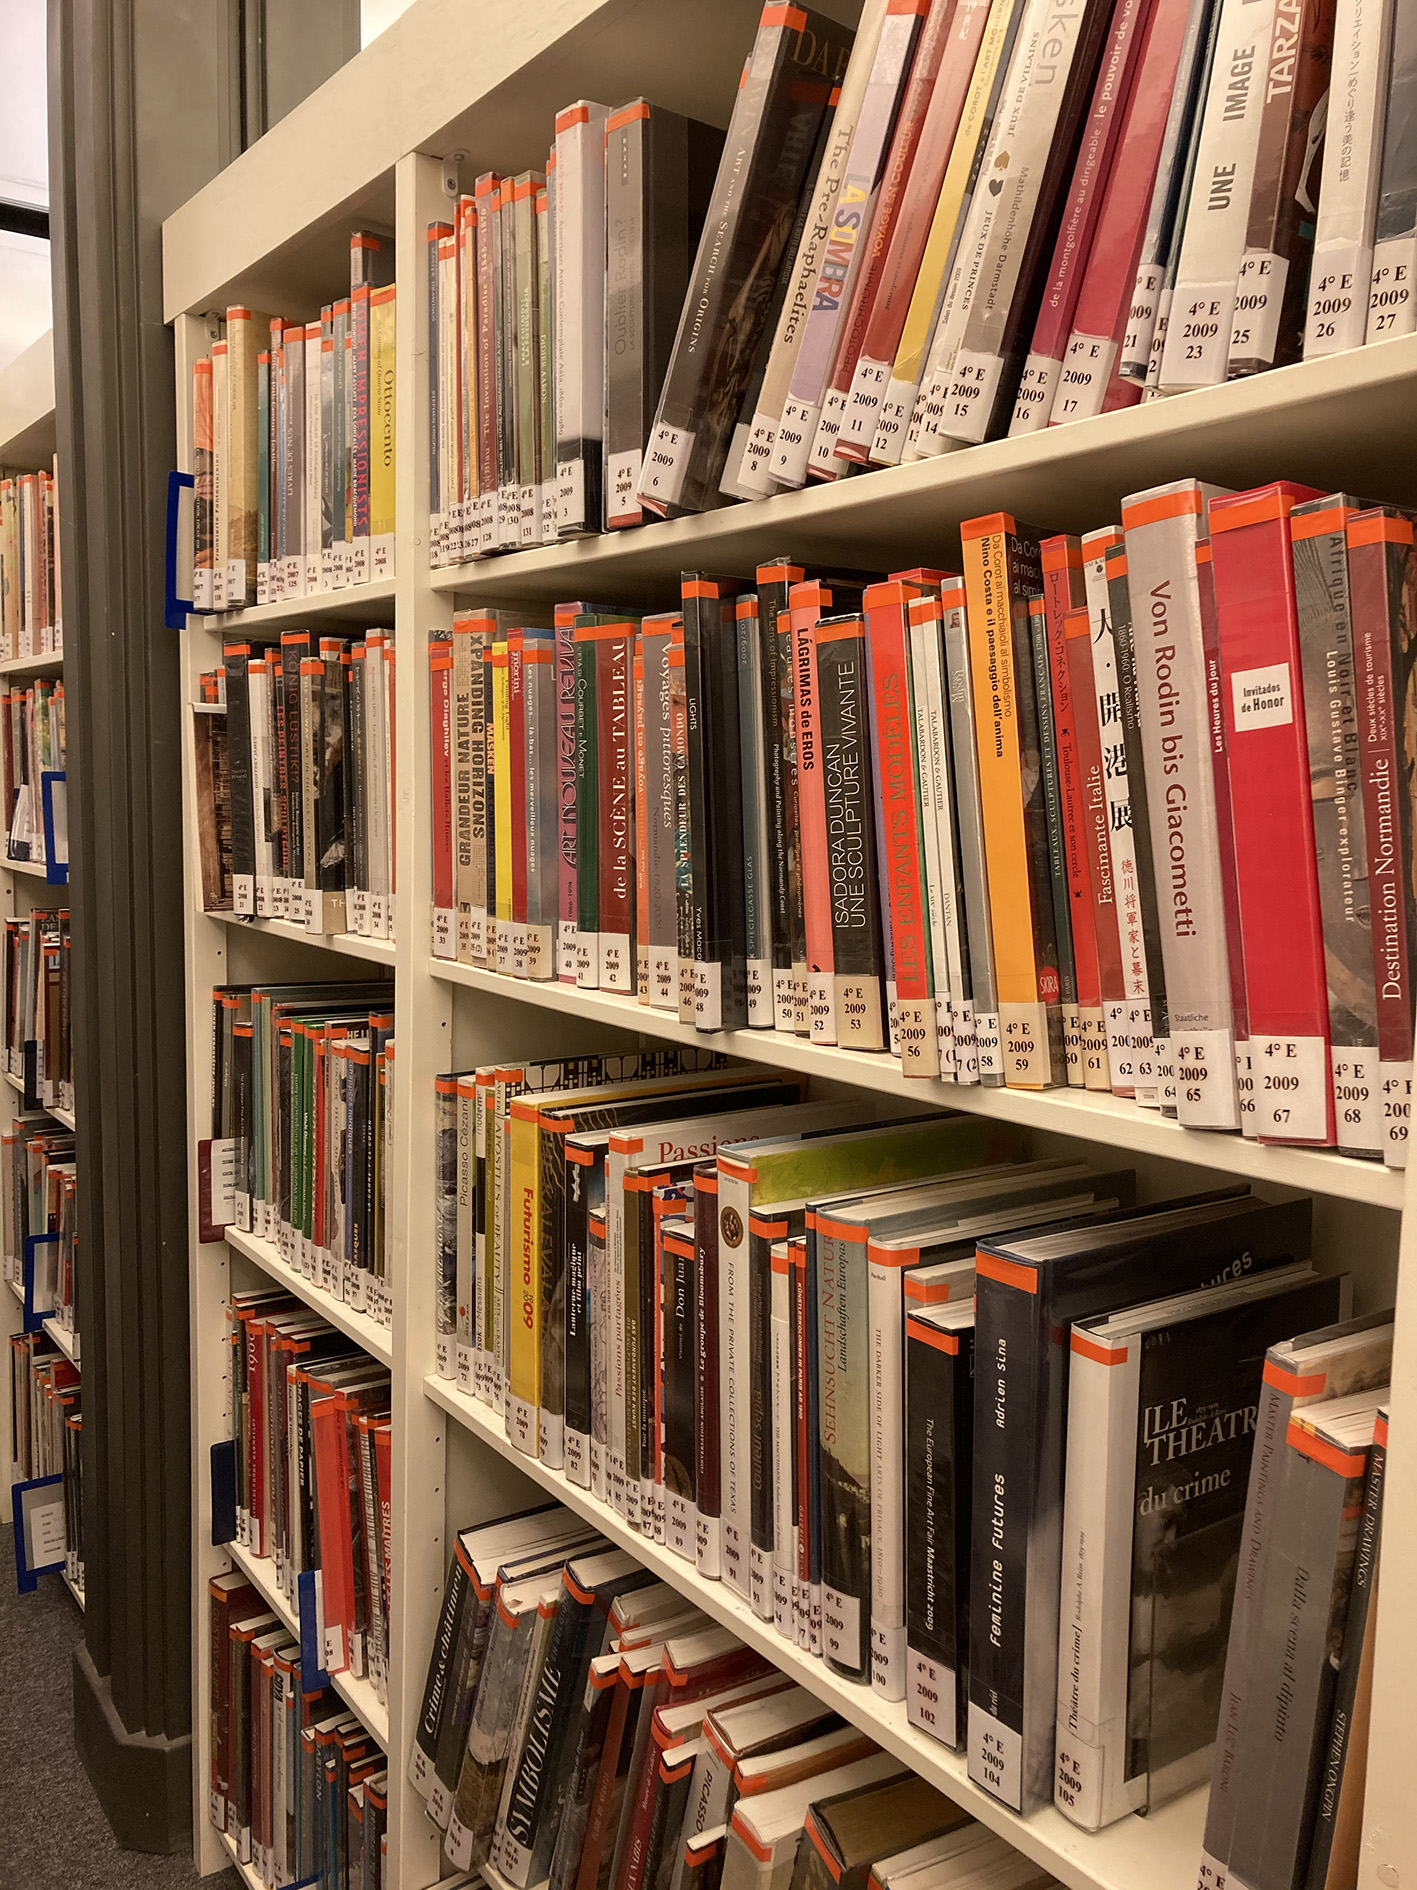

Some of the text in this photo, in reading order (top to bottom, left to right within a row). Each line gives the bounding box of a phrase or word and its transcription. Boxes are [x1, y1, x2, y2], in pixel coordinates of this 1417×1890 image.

[1021, 31, 1040, 86] VILAINS
[1207, 45, 1256, 211] UNE IMAGE
[1050, 43, 1122, 307] de montgolfière dirigeable pouvoir
[784, 124, 855, 343] The Pre-Raphaelites
[812, 173, 872, 312] LA SOMBRA
[872, 207, 892, 258] VOYAGE
[962, 210, 993, 310] JEUX PRINCES
[986, 167, 1030, 310] Mathildenhöhe Darmstadt
[689, 221, 728, 352] SEARCH ORIGINS
[1183, 323, 1218, 338] 2009
[1313, 298, 1351, 316] 2009
[1316, 322, 1335, 338] 26
[1375, 314, 1396, 330] 27
[481, 283, 490, 410] Invention Paradise
[1185, 345, 1203, 360] 23
[383, 369, 395, 467] Ottocento
[954, 404, 969, 417] 15
[1063, 400, 1078, 413] 17
[769, 658, 778, 727] Impressionism
[797, 627, 815, 772] LÁGRIMAS de EROS
[983, 569, 1004, 758] Costa paesaggio dell'anima
[1000, 658, 1012, 718] simbolismo
[1243, 683, 1281, 698] Invitados
[1253, 696, 1285, 712] Honor
[1363, 632, 1376, 721] siècles tourisme
[456, 692, 470, 765] NATURE
[470, 633, 485, 839] XPANDING HORIZONS
[486, 722, 495, 775] MASKEN
[578, 740, 588, 779] MONET
[773, 743, 781, 785] Photography
[931, 709, 944, 811] TALABARDON GAUTIER
[1150, 579, 1198, 939] Von Rodin bis Giacometti
[1338, 652, 1360, 792] Noir Blanc
[457, 768, 471, 867] GRANDEUR
[561, 712, 577, 833] NOUVEAU
[660, 726, 674, 829] pittoresques
[775, 800, 783, 828] Painting
[838, 661, 867, 928] UNE SCULPTURE VIVANTE
[1061, 742, 1075, 823] Toulouse-Lautrec
[1326, 651, 1355, 923] Louis Gustave explorateur
[610, 747, 627, 900] de la SCÈNE au
[679, 802, 690, 869] SPLENDEUR
[826, 743, 849, 929] ISADORA DUNCAN
[883, 672, 919, 983] LES ENFANTS MODÈLES
[1086, 764, 1114, 906] Fascinante Italie
[943, 892, 952, 927] DANTAN
[1369, 757, 1403, 1001] Destination Normandie
[1040, 975, 1059, 995] SKIRA
[1016, 1059, 1029, 1070] 59
[1186, 1088, 1201, 1102] 65
[1264, 1076, 1299, 1090] 2009
[1273, 1108, 1290, 1123] 67
[1344, 1109, 1361, 1123] 68
[460, 1153, 469, 1207] Picasso
[522, 1187, 534, 1286] Futurismo
[569, 1243, 577, 1336] Lanterne magique
[675, 1289, 685, 1318] Don
[698, 1247, 707, 1359] groupe Bloomsbury
[614, 1280, 623, 1398] Passions partagées
[823, 1316, 838, 1446] SEHNSUCHT
[727, 1261, 738, 1515] FROM PRIVATE COLLECTIONS TEXAS
[875, 1350, 883, 1461] DARKER LIGHT
[995, 1379, 1007, 1429] Adrien
[1145, 1405, 1259, 1467] THEATR
[922, 1437, 936, 1603] European Maastricht
[1139, 1468, 1232, 1517] du crime
[1357, 1454, 1383, 1588] MASTER DRAWINGS
[424, 1680, 444, 1735] Crime
[508, 1658, 561, 1847] SYMBOLISME
[1275, 1681, 1295, 1743] dipinto
[696, 1771, 714, 1833] PICASSO
[1321, 1711, 1348, 1822] STEPHEN ONGPIN
